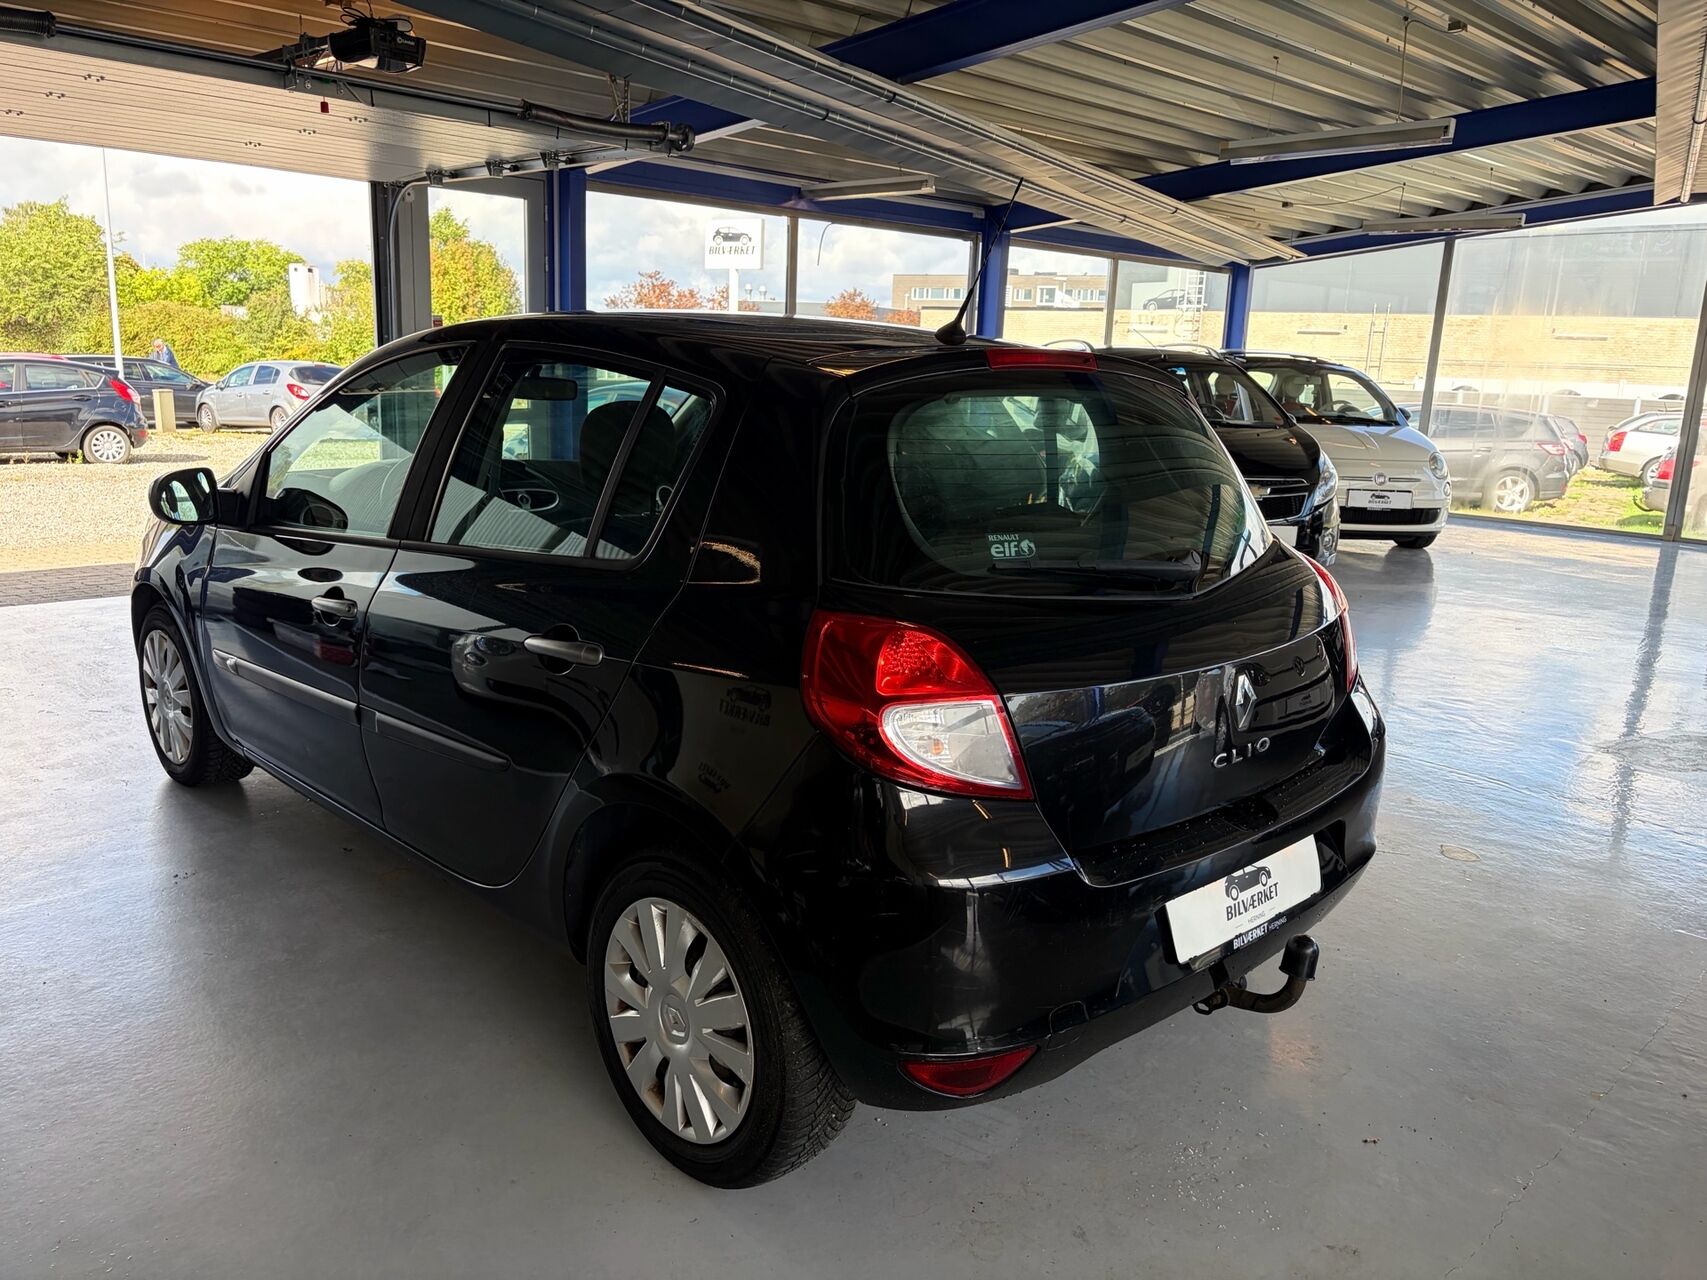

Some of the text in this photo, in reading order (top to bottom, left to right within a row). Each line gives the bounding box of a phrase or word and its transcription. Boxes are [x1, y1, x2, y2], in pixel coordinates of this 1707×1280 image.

[988, 533, 1019, 541] RENAULT
[990, 541, 1018, 557] elf
[1213, 737, 1271, 768] CLIO
[1226, 882, 1279, 921] BILVÆRKET
[1233, 922, 1269, 950] BILVÆRKET
